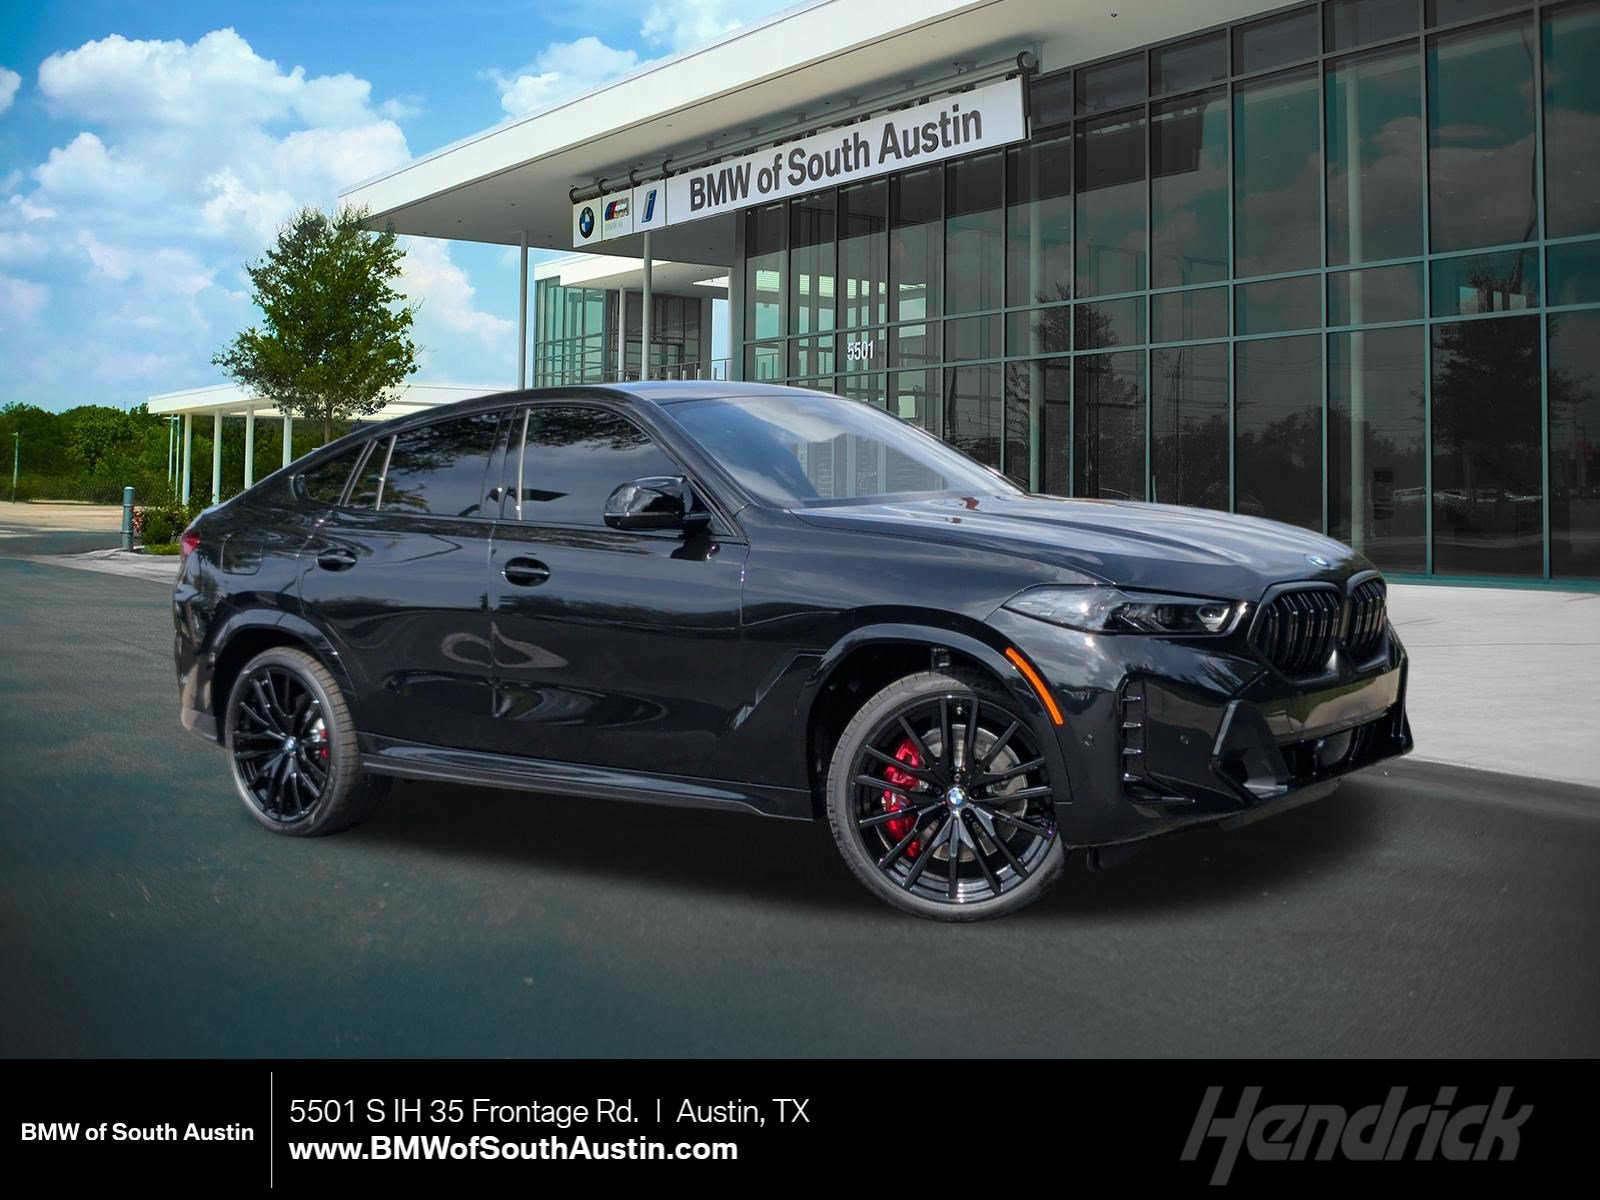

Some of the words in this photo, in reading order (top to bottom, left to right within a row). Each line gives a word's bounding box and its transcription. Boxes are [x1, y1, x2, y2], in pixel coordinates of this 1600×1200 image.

[690, 162, 751, 212] BMW
[757, 153, 783, 195] of
[787, 131, 870, 187] South
[878, 104, 982, 164] Austin
[847, 340, 873, 361] 5501
